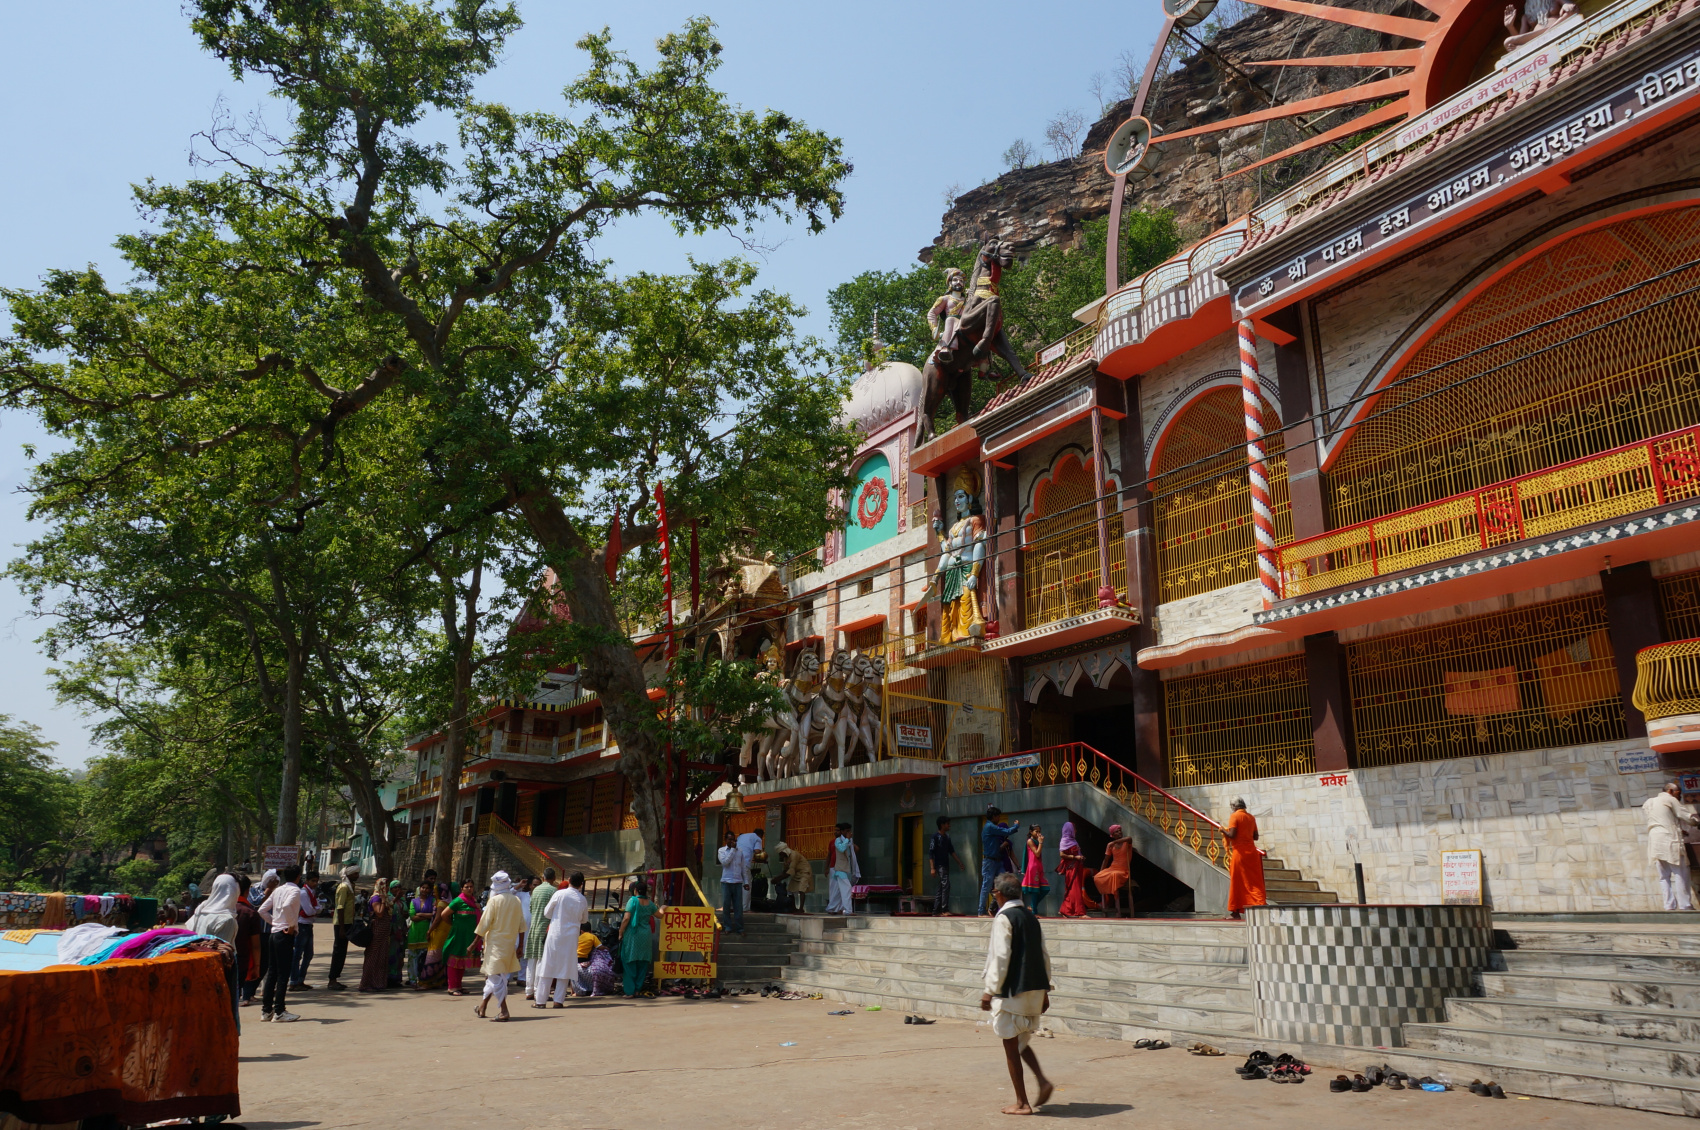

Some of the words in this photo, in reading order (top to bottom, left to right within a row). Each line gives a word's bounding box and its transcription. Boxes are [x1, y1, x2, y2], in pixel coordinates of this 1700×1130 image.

[1402, 122, 1429, 144] तारा
[1431, 96, 1474, 126] मण्डल
[1258, 277, 1274, 296] ॐ
[1288, 255, 1307, 281] श्री
[1322, 231, 1363, 262] परम
[1378, 207, 1410, 236] हंस
[1319, 773, 1348, 787] प्रवेश
[664, 907, 692, 929] प्रवेश
[694, 912, 712, 929] द्वार
[665, 931, 691, 950] कृपया
[688, 941, 713, 951] चप्पल
[679, 964, 691, 975] पर
